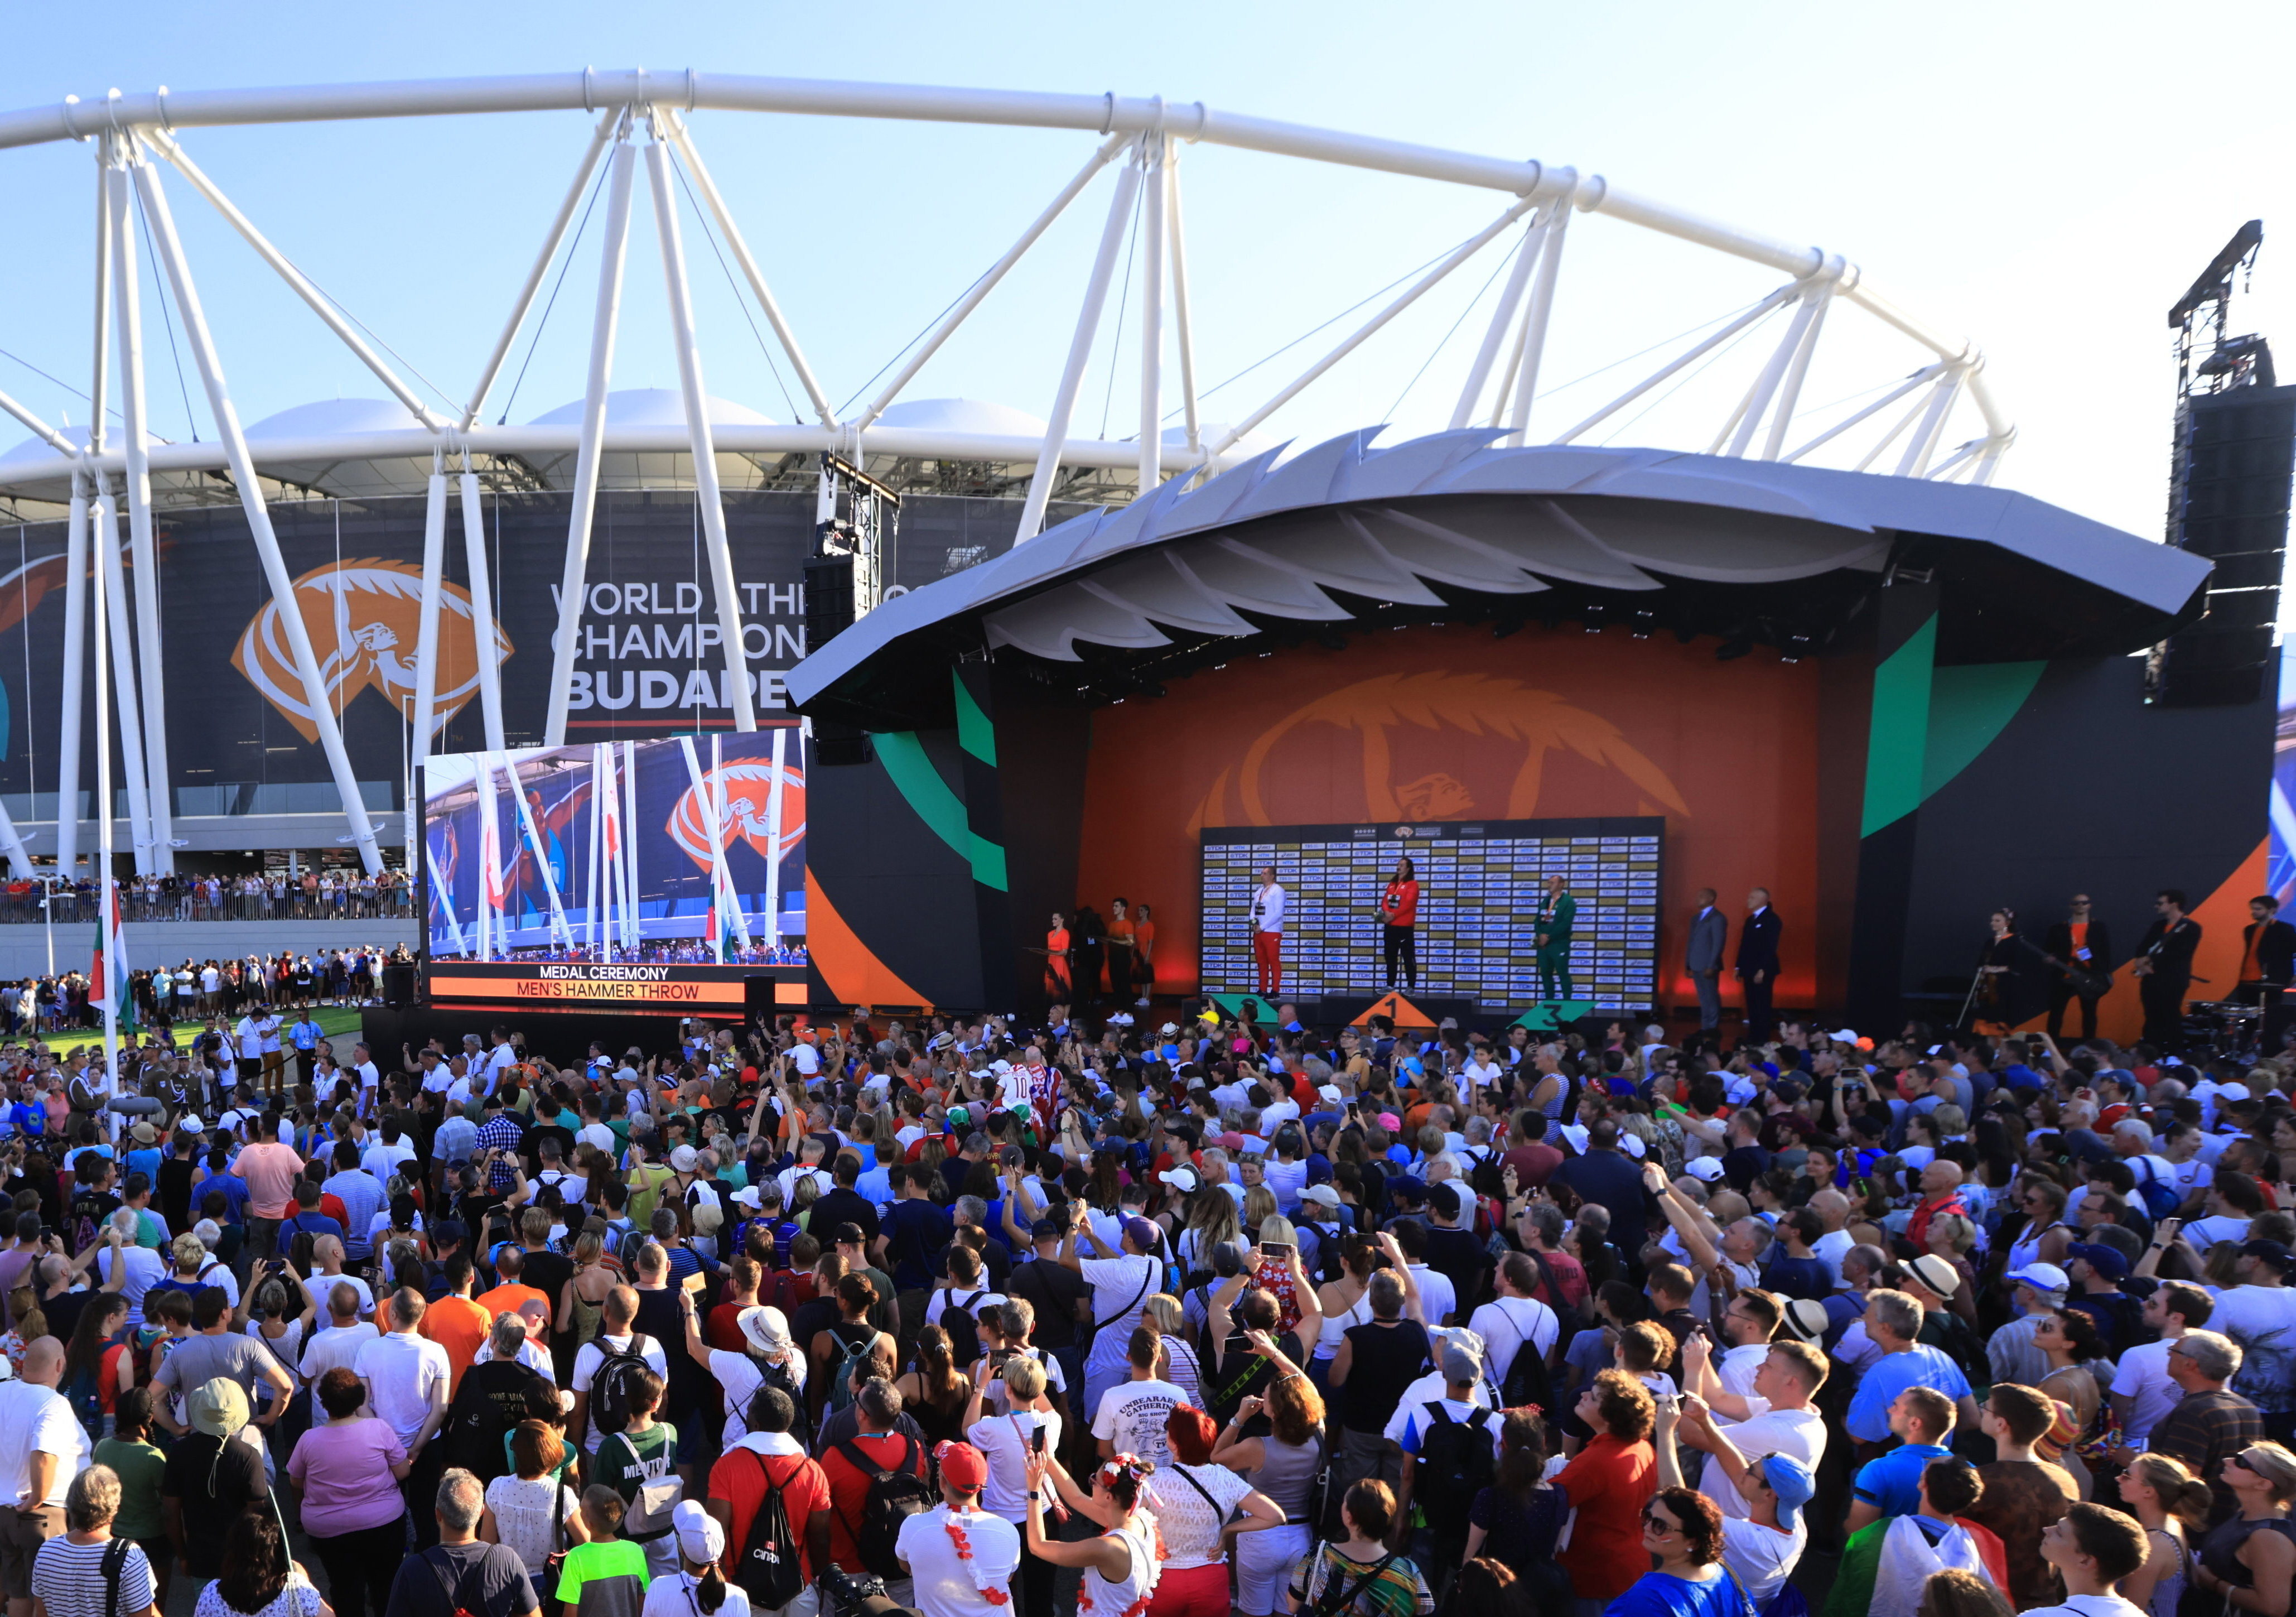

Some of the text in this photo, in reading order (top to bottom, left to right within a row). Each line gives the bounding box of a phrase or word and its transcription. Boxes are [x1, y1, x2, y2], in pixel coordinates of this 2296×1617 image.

[539, 966, 669, 981] MEDAL CEREMONY
[517, 981, 699, 999] MEN'S HAMMER THROW
[1385, 998, 1396, 1019] 1
[1542, 1004, 1562, 1027] 3
[1014, 1077, 1027, 1099] 10
[753, 1548, 780, 1565] CANADA
